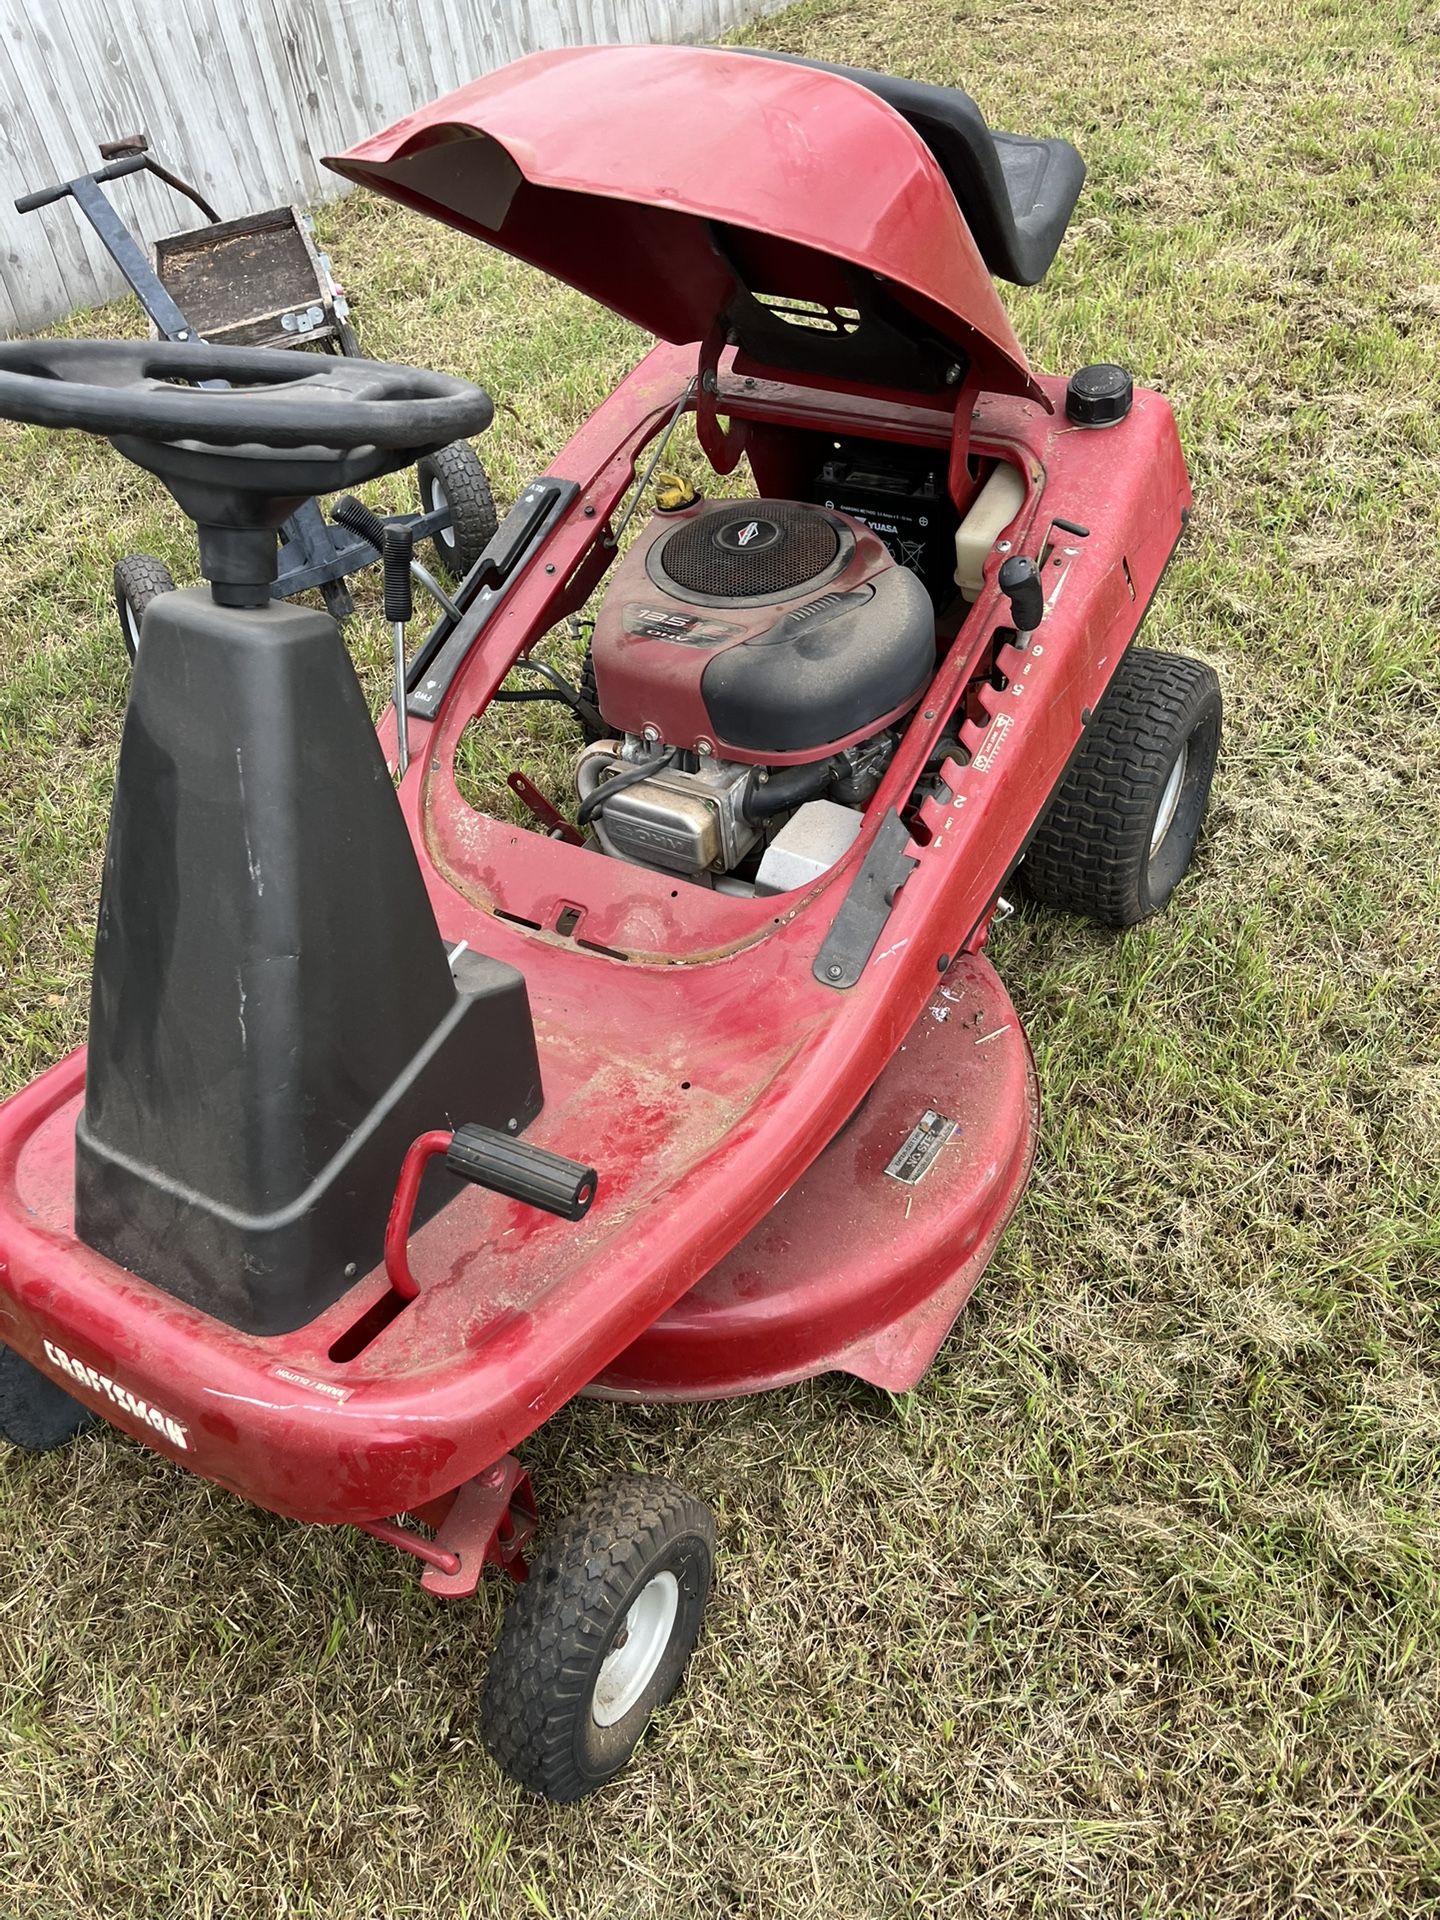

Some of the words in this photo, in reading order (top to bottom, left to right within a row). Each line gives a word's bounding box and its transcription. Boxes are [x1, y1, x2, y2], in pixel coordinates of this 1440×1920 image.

[867, 521, 898, 534] YUASA
[1031, 644, 1044, 657] 6
[414, 691, 433, 702] FWD
[1011, 684, 1025, 696] 5
[996, 715, 1008, 727] 4
[975, 755, 988, 768] 3
[953, 794, 968, 808] 2
[933, 835, 943, 848] 1
[906, 1153, 921, 1168] NO
[43, 1339, 188, 1449] CRAFTSMAN
